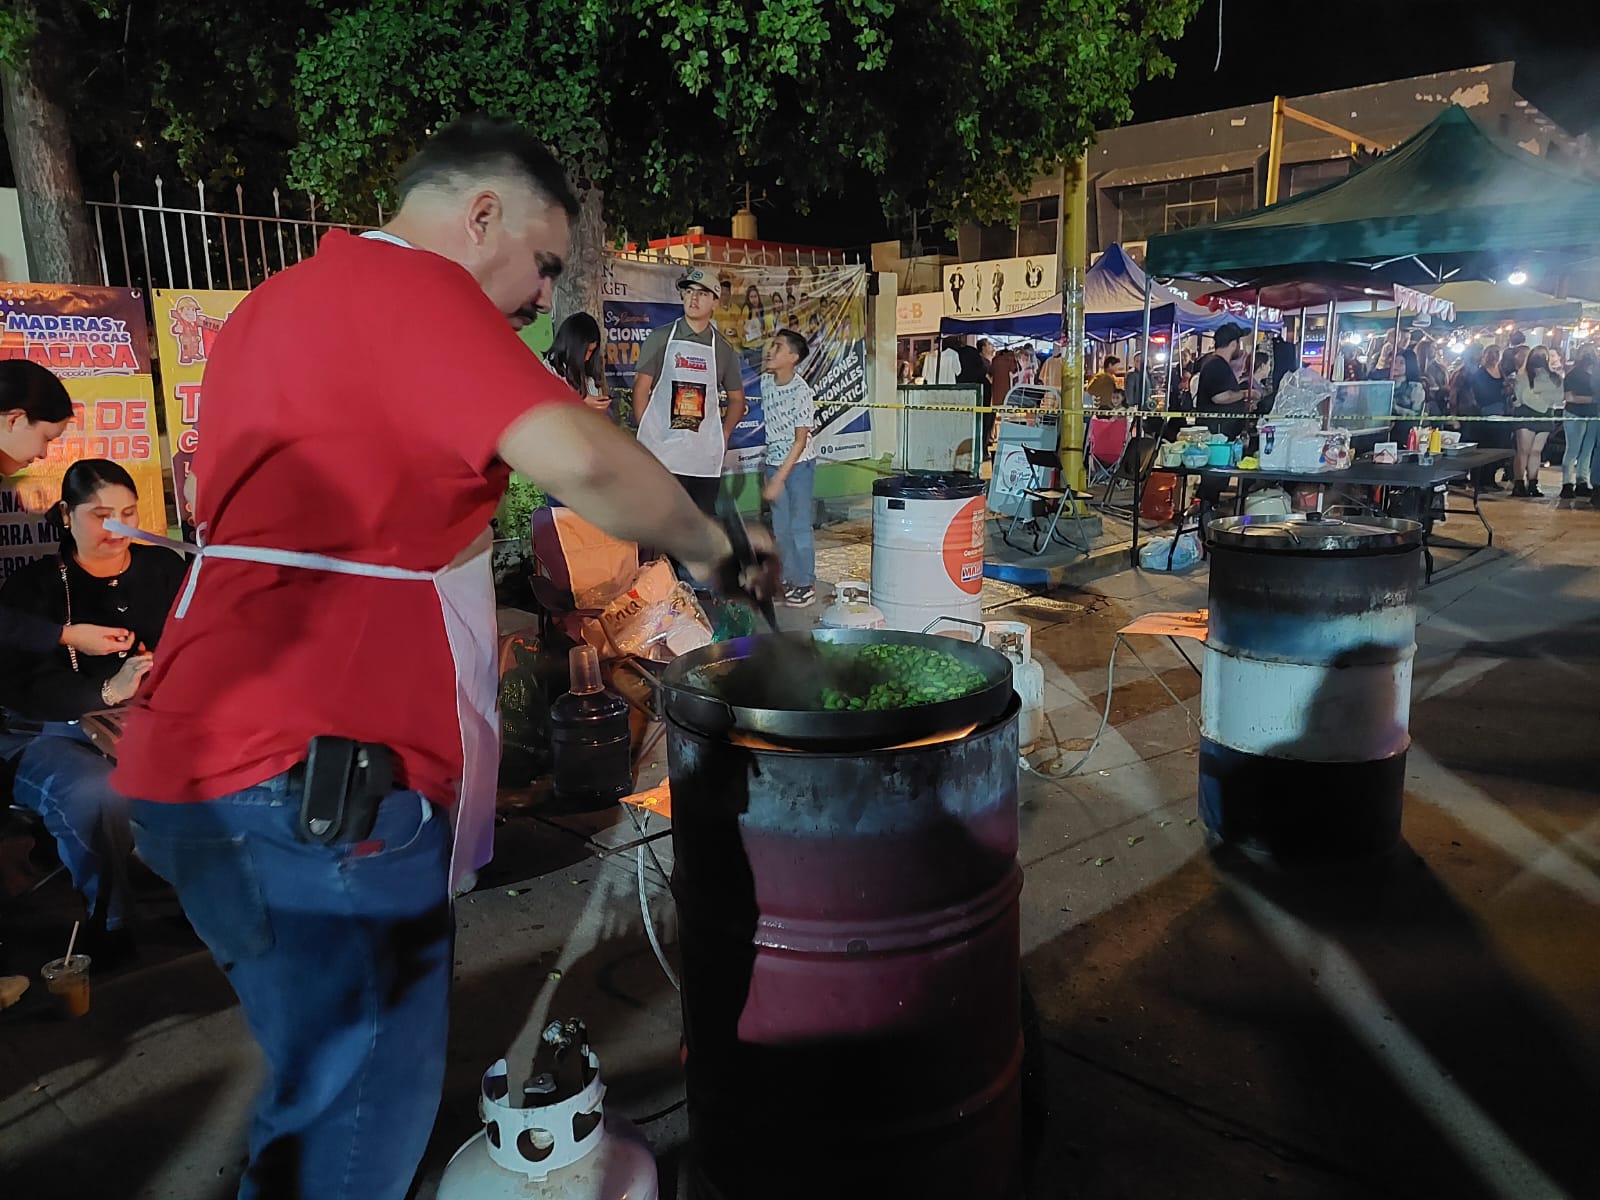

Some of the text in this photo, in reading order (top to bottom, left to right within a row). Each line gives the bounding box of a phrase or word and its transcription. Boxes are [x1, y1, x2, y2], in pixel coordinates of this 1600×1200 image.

[8, 315, 125, 333] MADERAS Y
[813, 351, 859, 394] AMPEONES
[96, 401, 147, 431] DE
